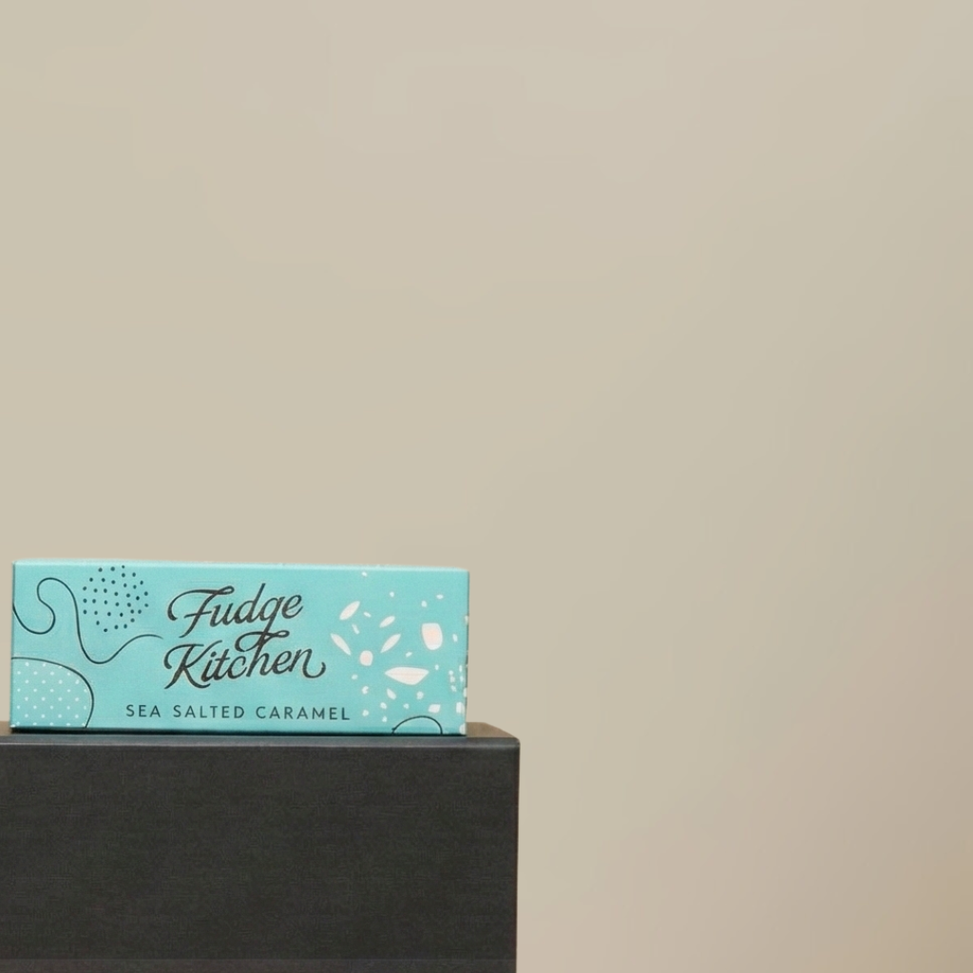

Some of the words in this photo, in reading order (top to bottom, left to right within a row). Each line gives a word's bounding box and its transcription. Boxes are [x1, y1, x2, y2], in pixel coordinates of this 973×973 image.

[167, 583, 303, 645] Fudge
[164, 636, 326, 690] Kitchen
[126, 704, 161, 718] SEA
[173, 705, 245, 719] SALTED
[256, 706, 350, 721] CARAMEL
